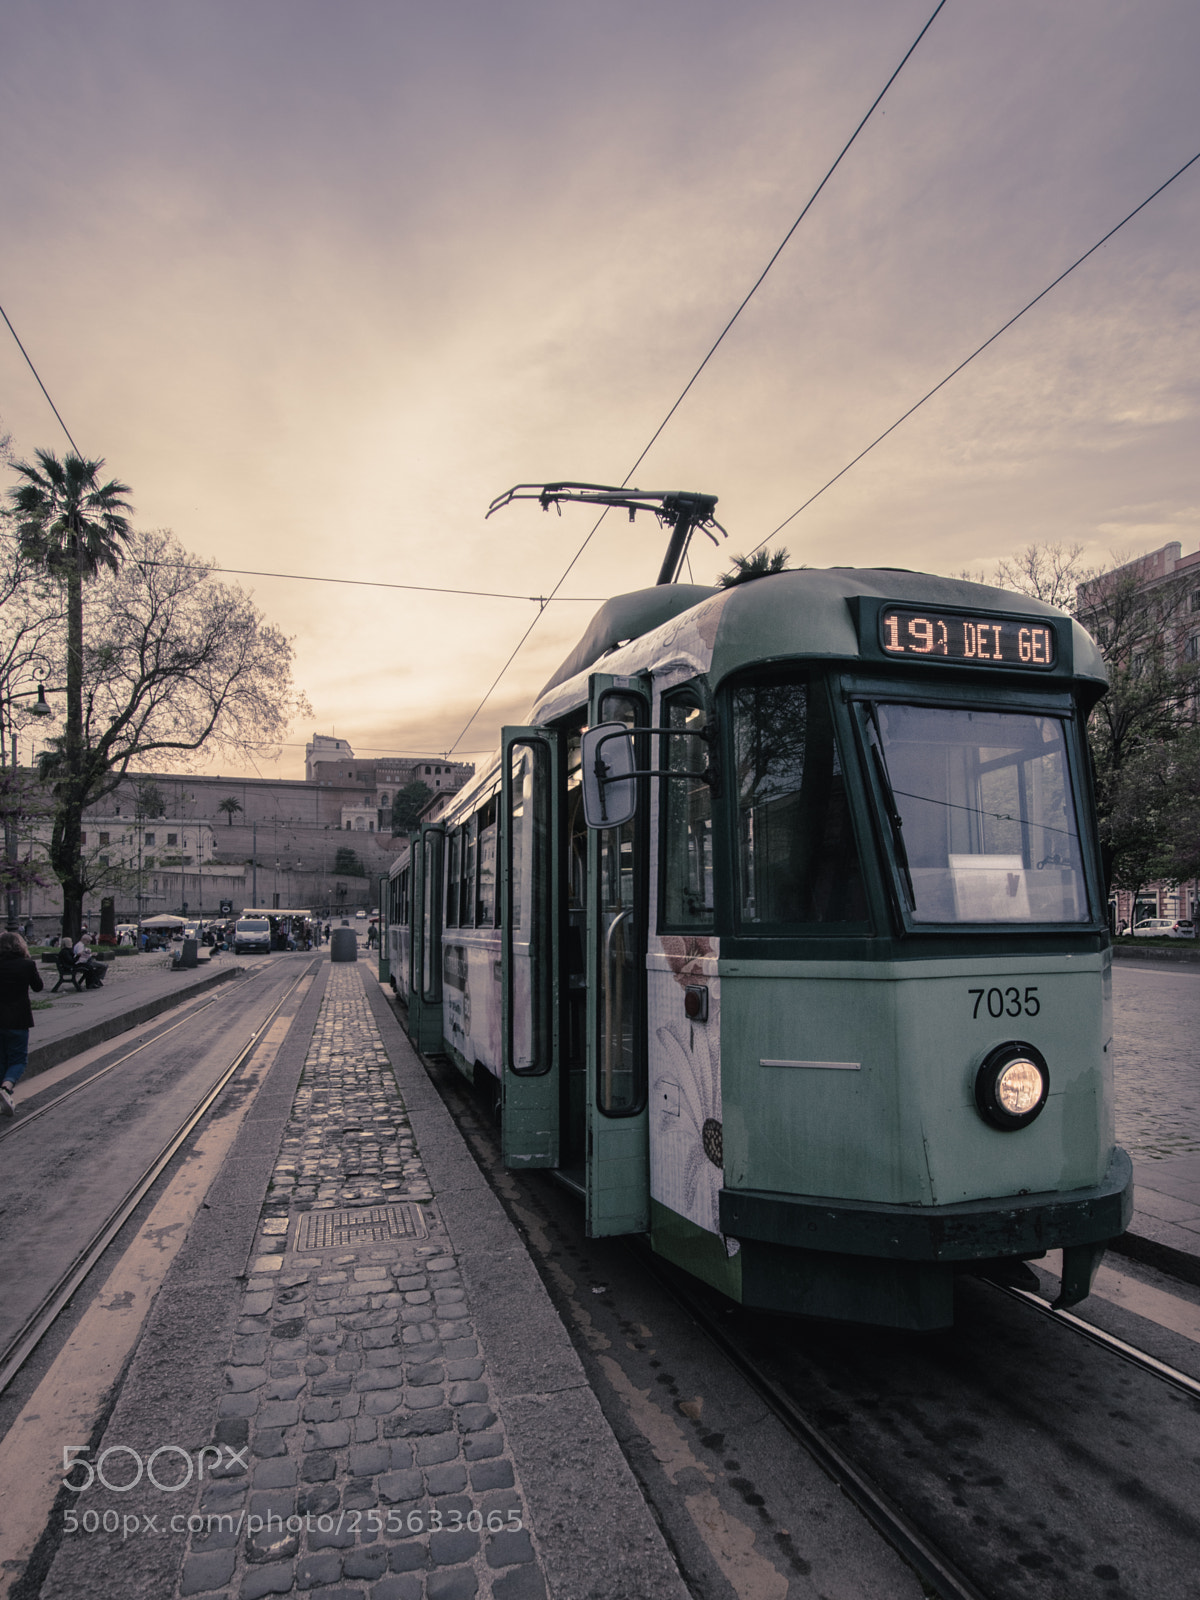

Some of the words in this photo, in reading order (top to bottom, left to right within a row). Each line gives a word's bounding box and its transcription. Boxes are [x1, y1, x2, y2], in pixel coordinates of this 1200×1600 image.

[884, 616, 934, 653] 19
[963, 622, 1003, 660] DEI
[968, 987, 1040, 1019] 7035
